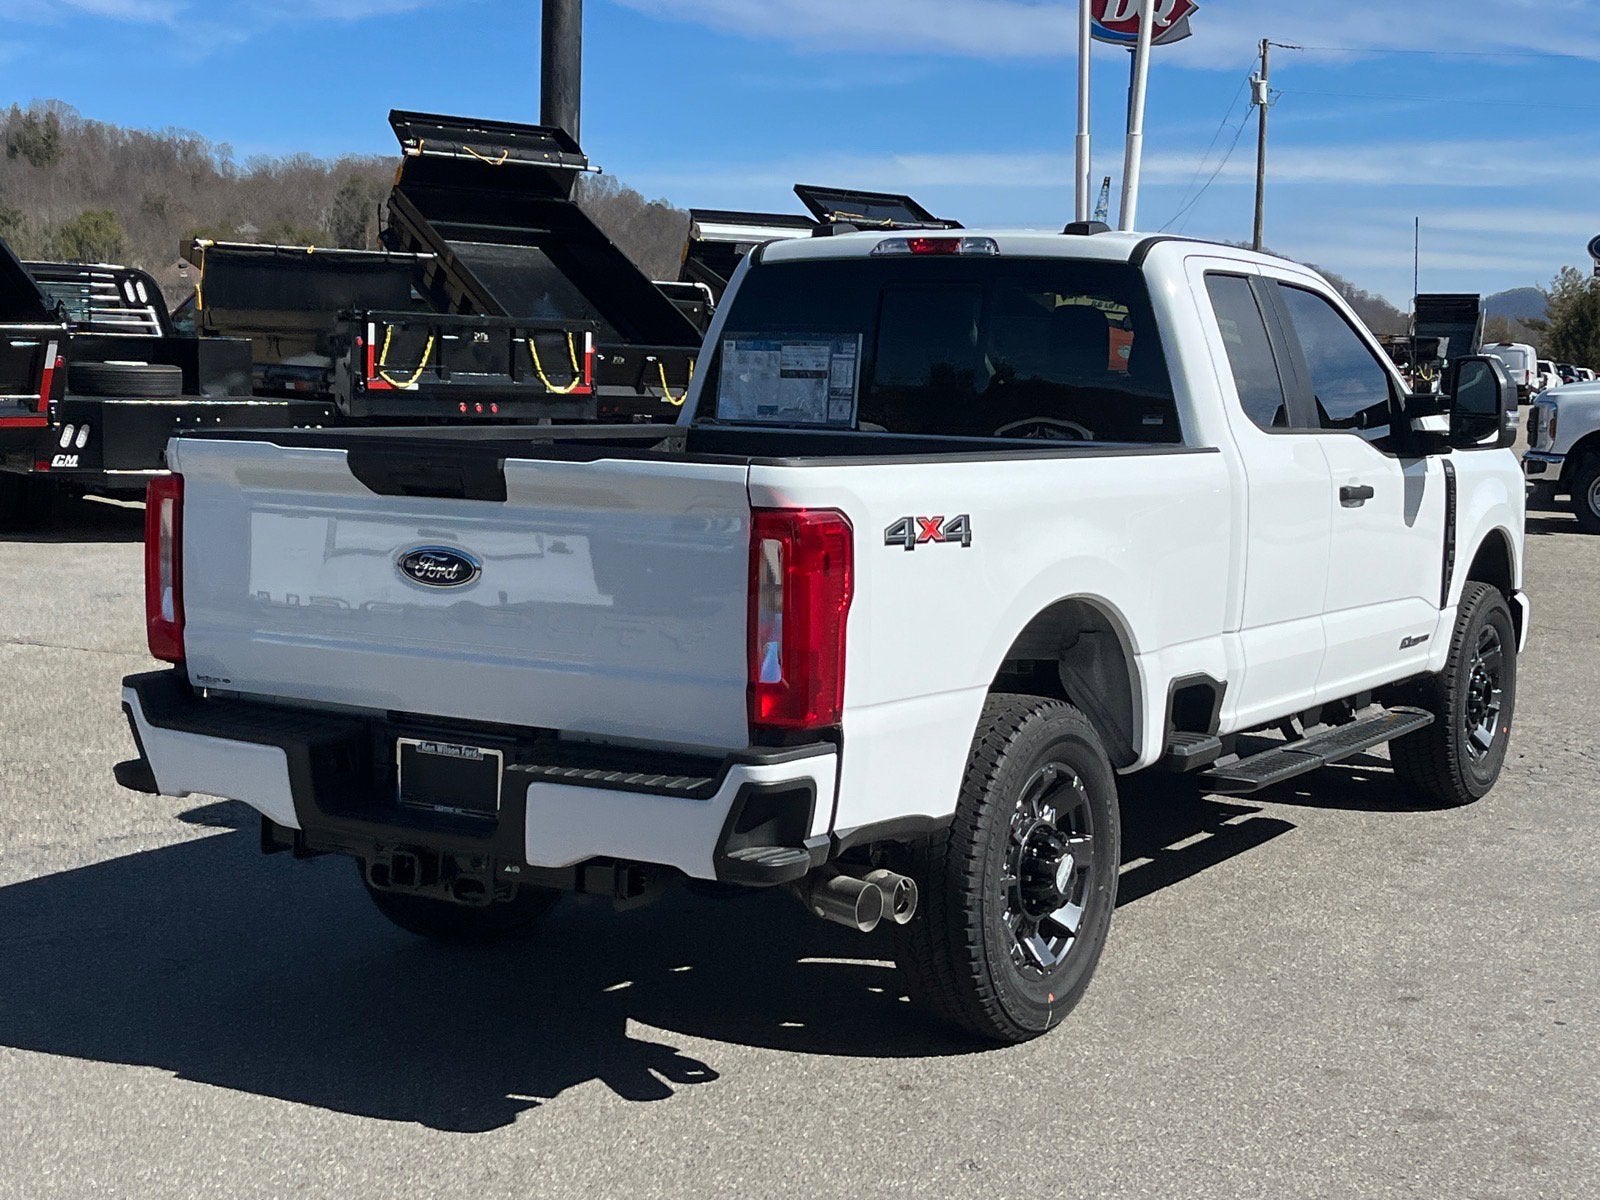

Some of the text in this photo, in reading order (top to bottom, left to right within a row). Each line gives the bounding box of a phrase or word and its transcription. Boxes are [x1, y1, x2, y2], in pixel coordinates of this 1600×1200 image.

[51, 454, 79, 468] CM
[414, 554, 461, 580] Ford
[421, 741, 478, 758] Ken Wilson Ford
